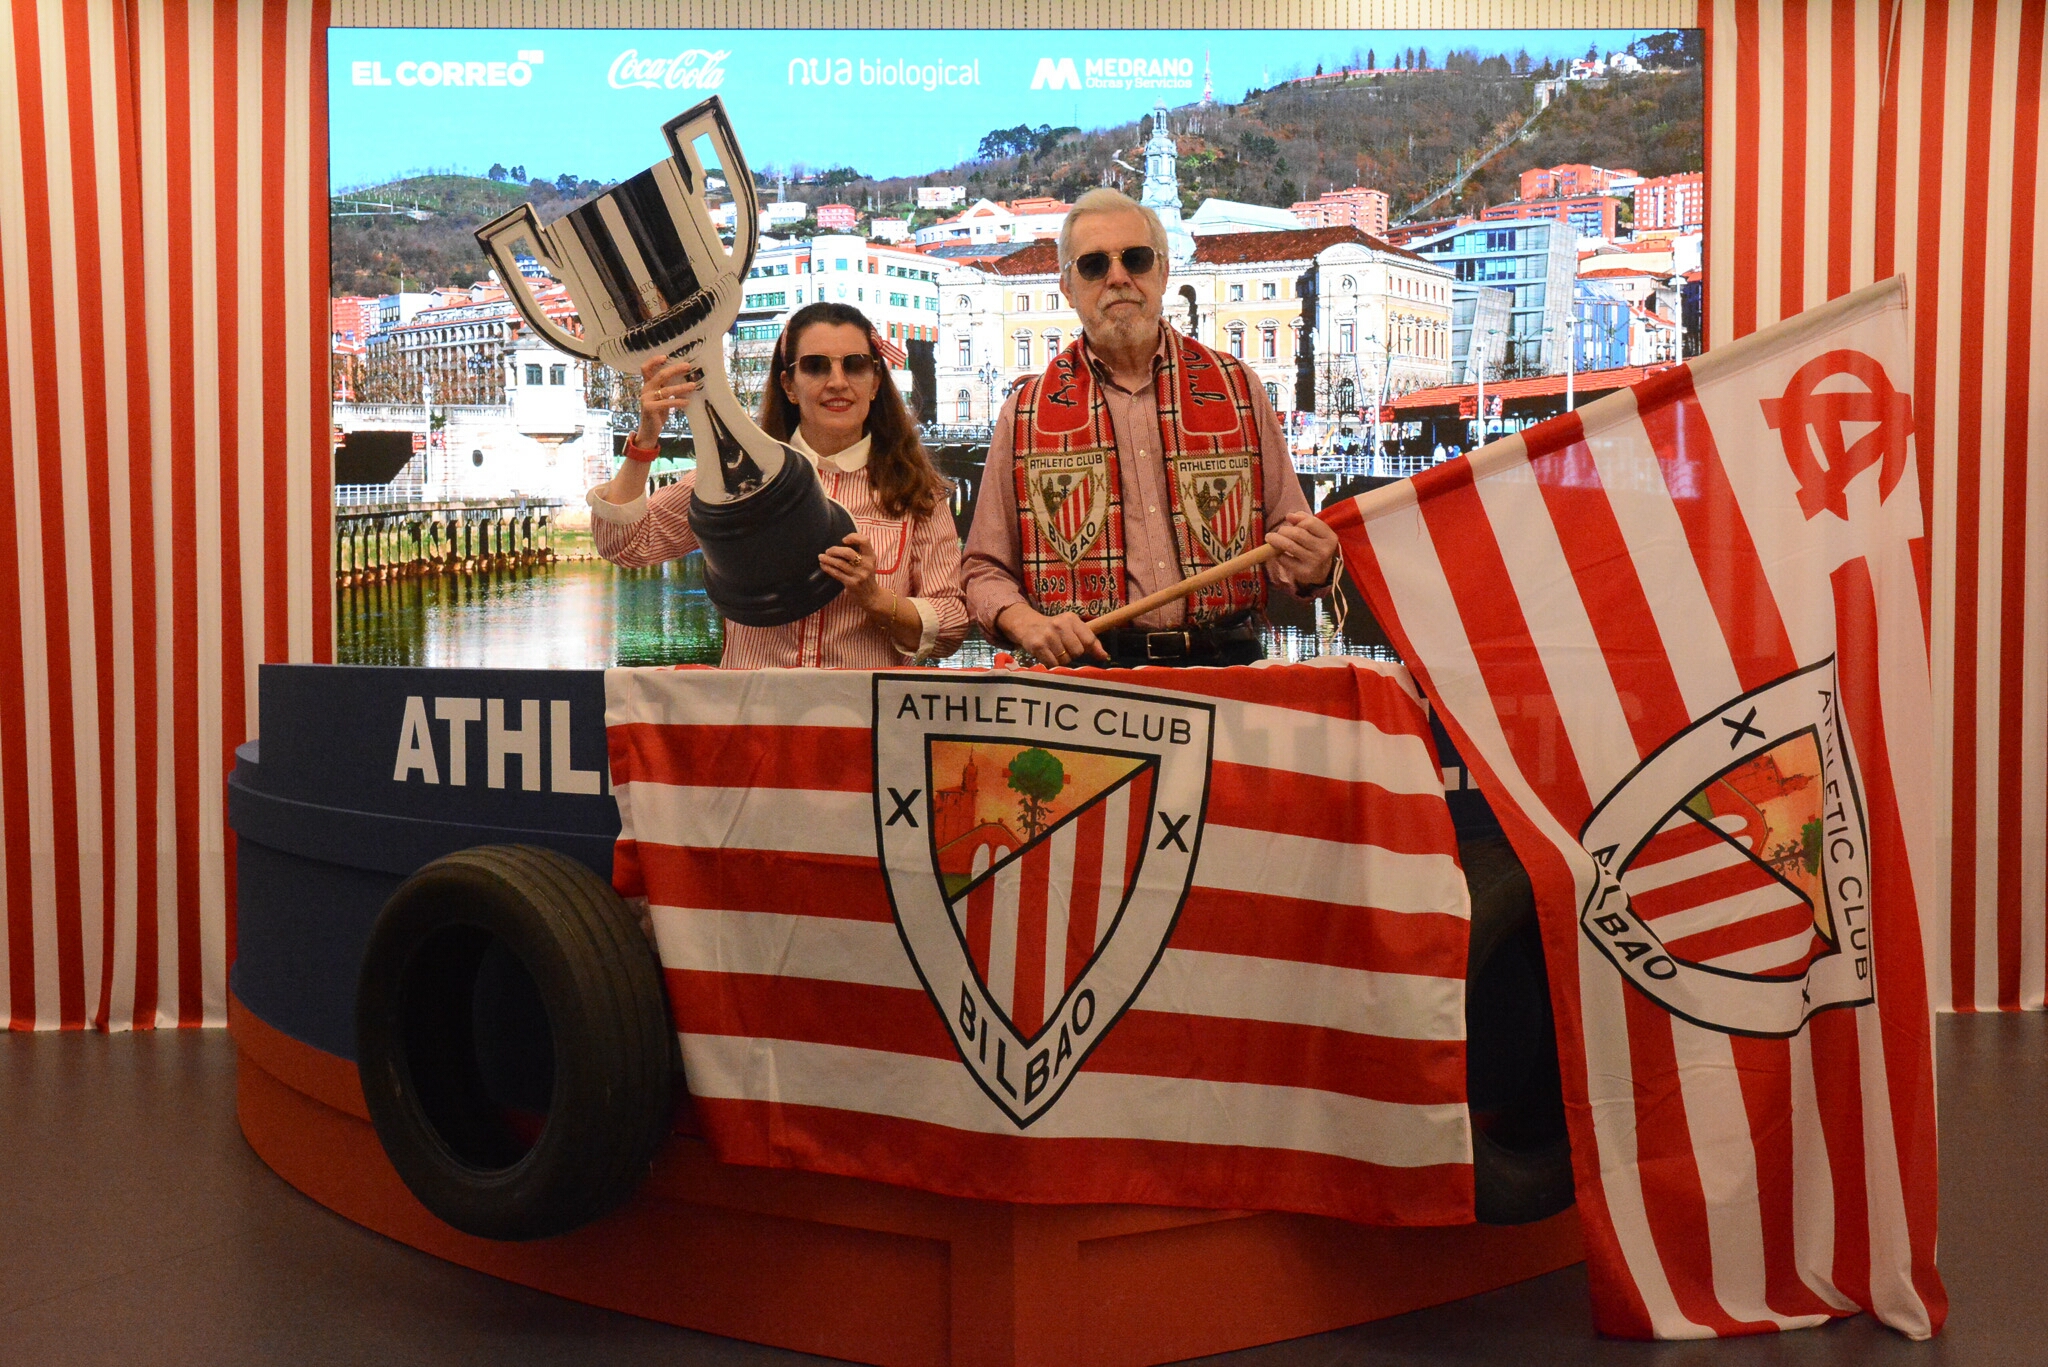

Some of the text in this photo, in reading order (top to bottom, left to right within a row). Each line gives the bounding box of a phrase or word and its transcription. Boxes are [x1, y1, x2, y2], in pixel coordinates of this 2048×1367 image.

[352, 61, 532, 87] EL CORREO
[859, 57, 981, 91] biological
[1085, 58, 1194, 77] MEDRANO
[1085, 77, 1193, 91] Obras y Servicios
[1030, 454, 1103, 469] ATHLETIC CLUB
[1180, 458, 1249, 472] ATHLETIC CLUB
[1048, 521, 1095, 561] BILBAO
[1084, 573, 1117, 592] 1998
[896, 693, 1192, 745] ATHLETIC CLUB
[393, 696, 616, 796] ATHL
[1838, 876, 1868, 981] CLUB
[959, 980, 1096, 1107] BILBAO
